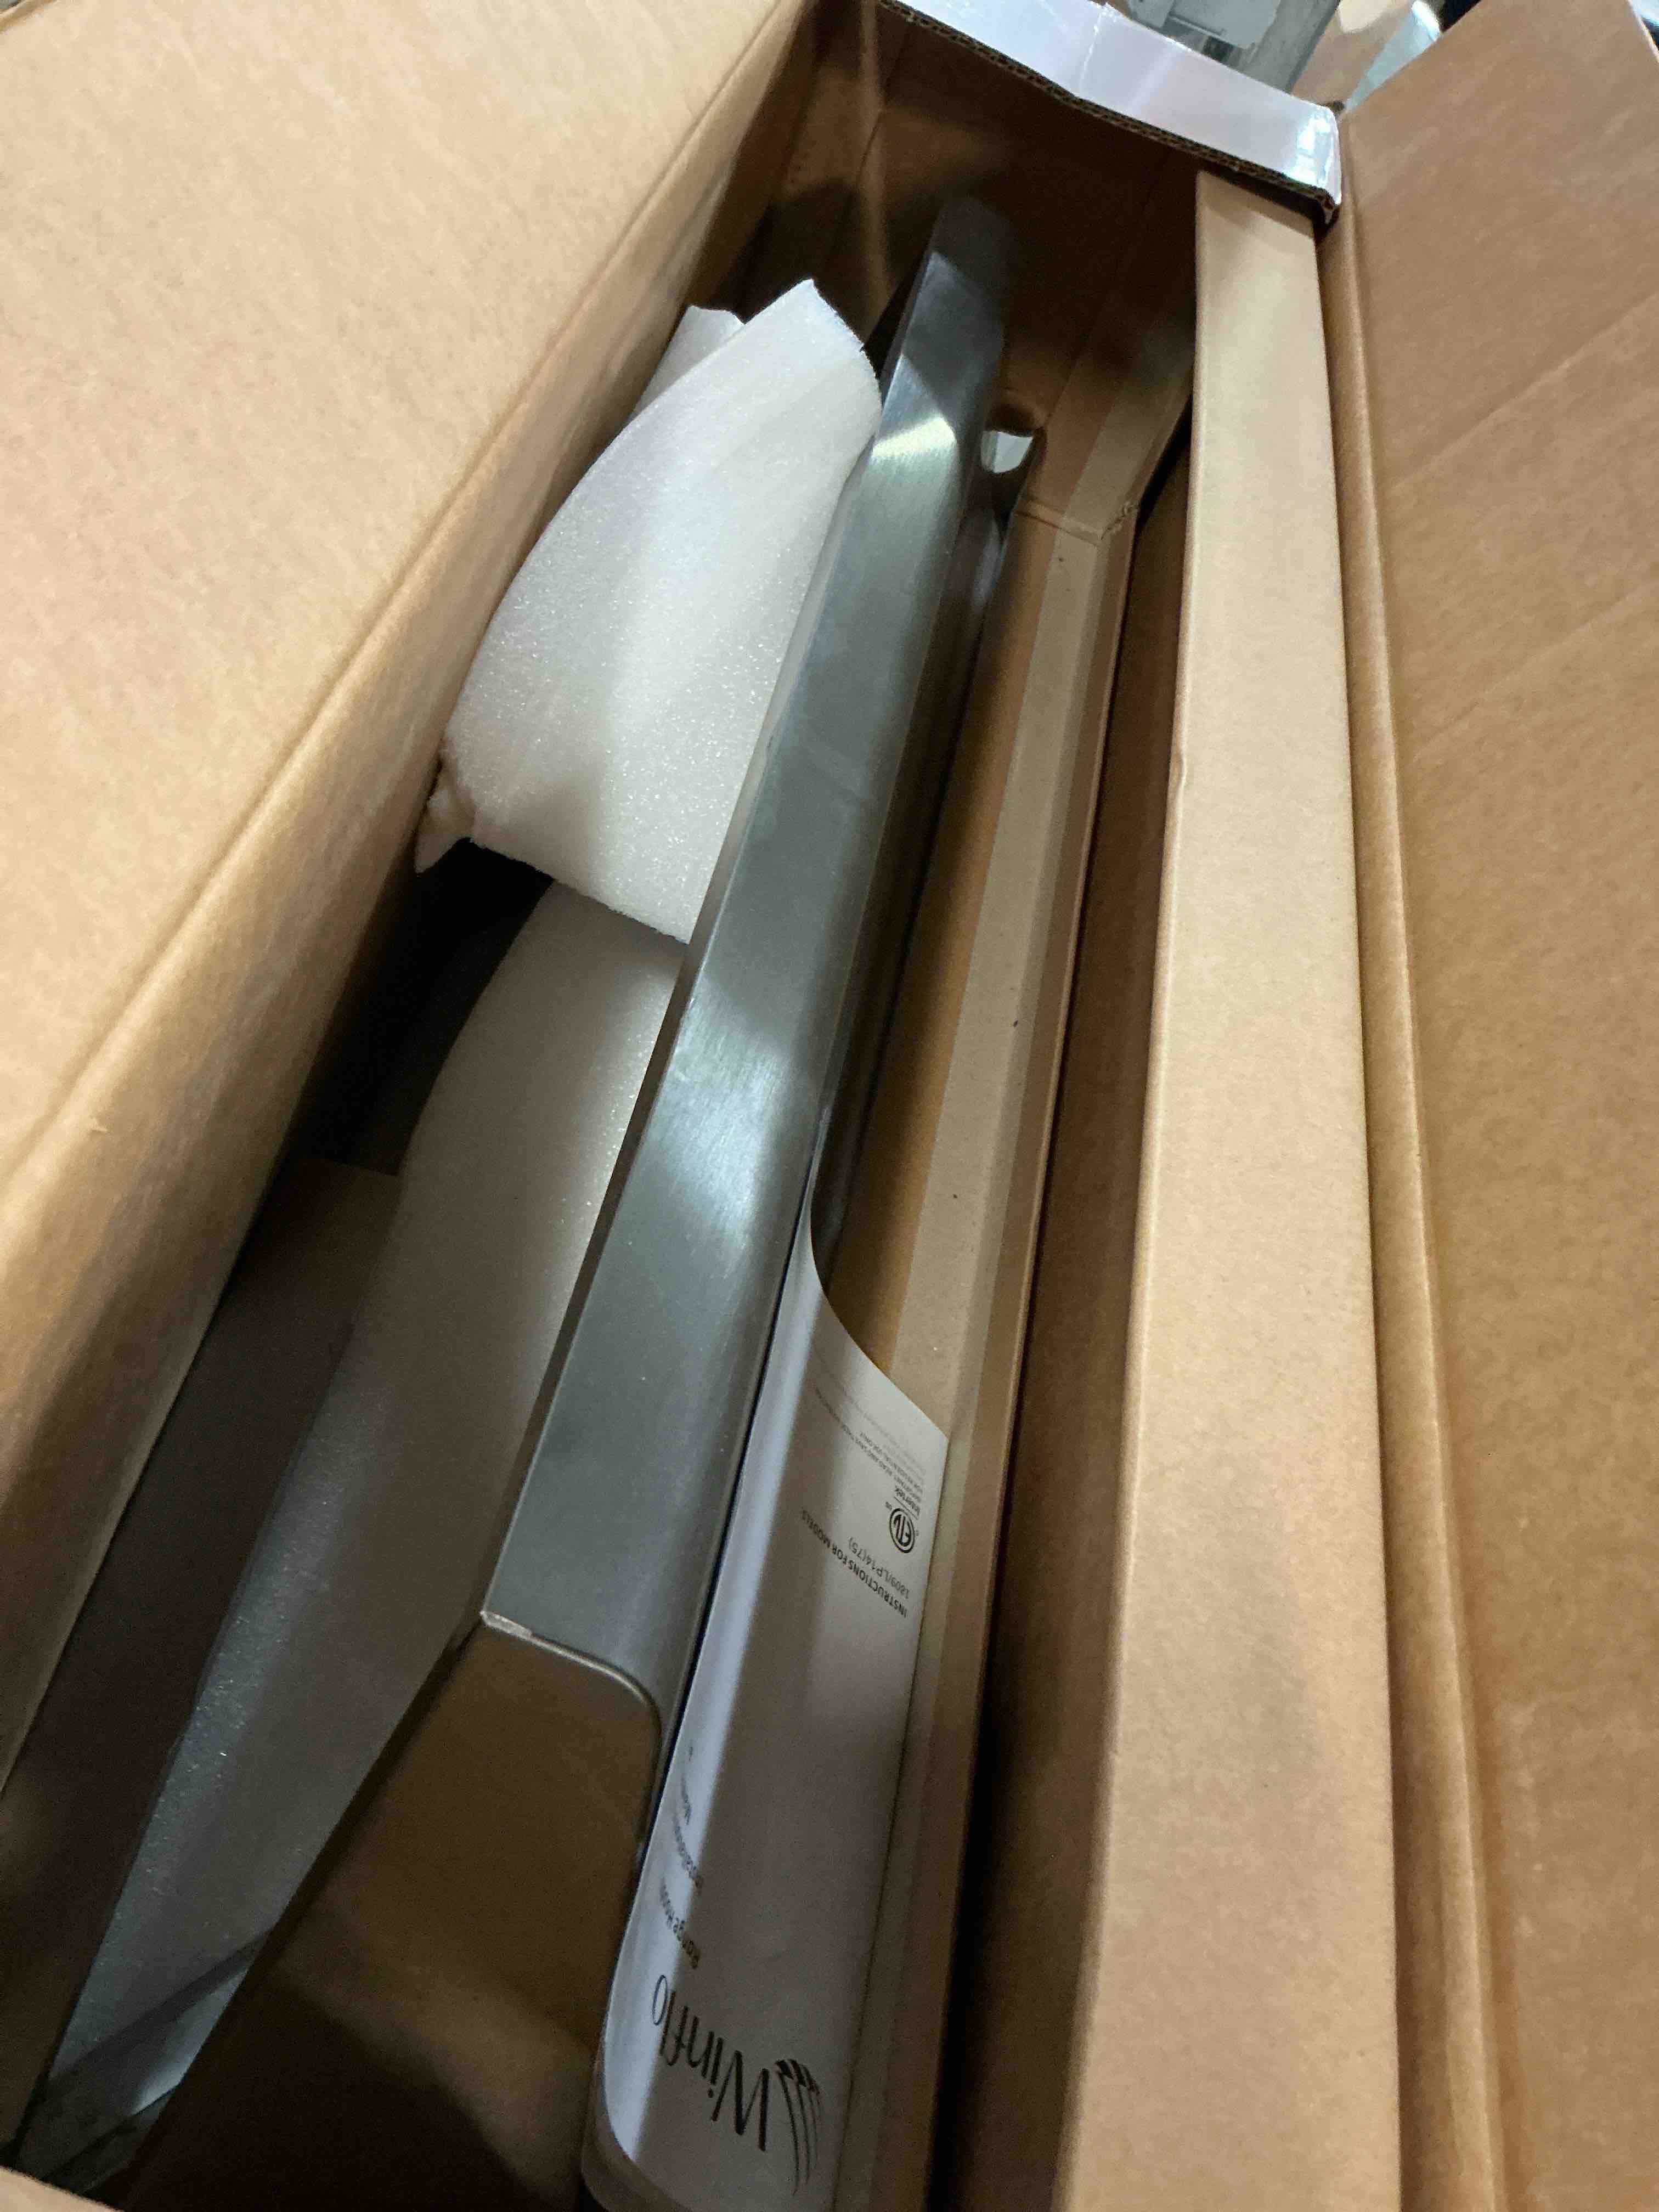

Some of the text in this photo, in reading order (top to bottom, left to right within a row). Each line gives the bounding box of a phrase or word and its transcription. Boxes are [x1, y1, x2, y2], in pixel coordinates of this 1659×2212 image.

[895, 1484, 921, 1519] Intertek
[832, 1543, 849, 1565] FOR
[849, 1559, 907, 1618] INSTRUCTIONS
[652, 1974, 770, 2152] Winflo
